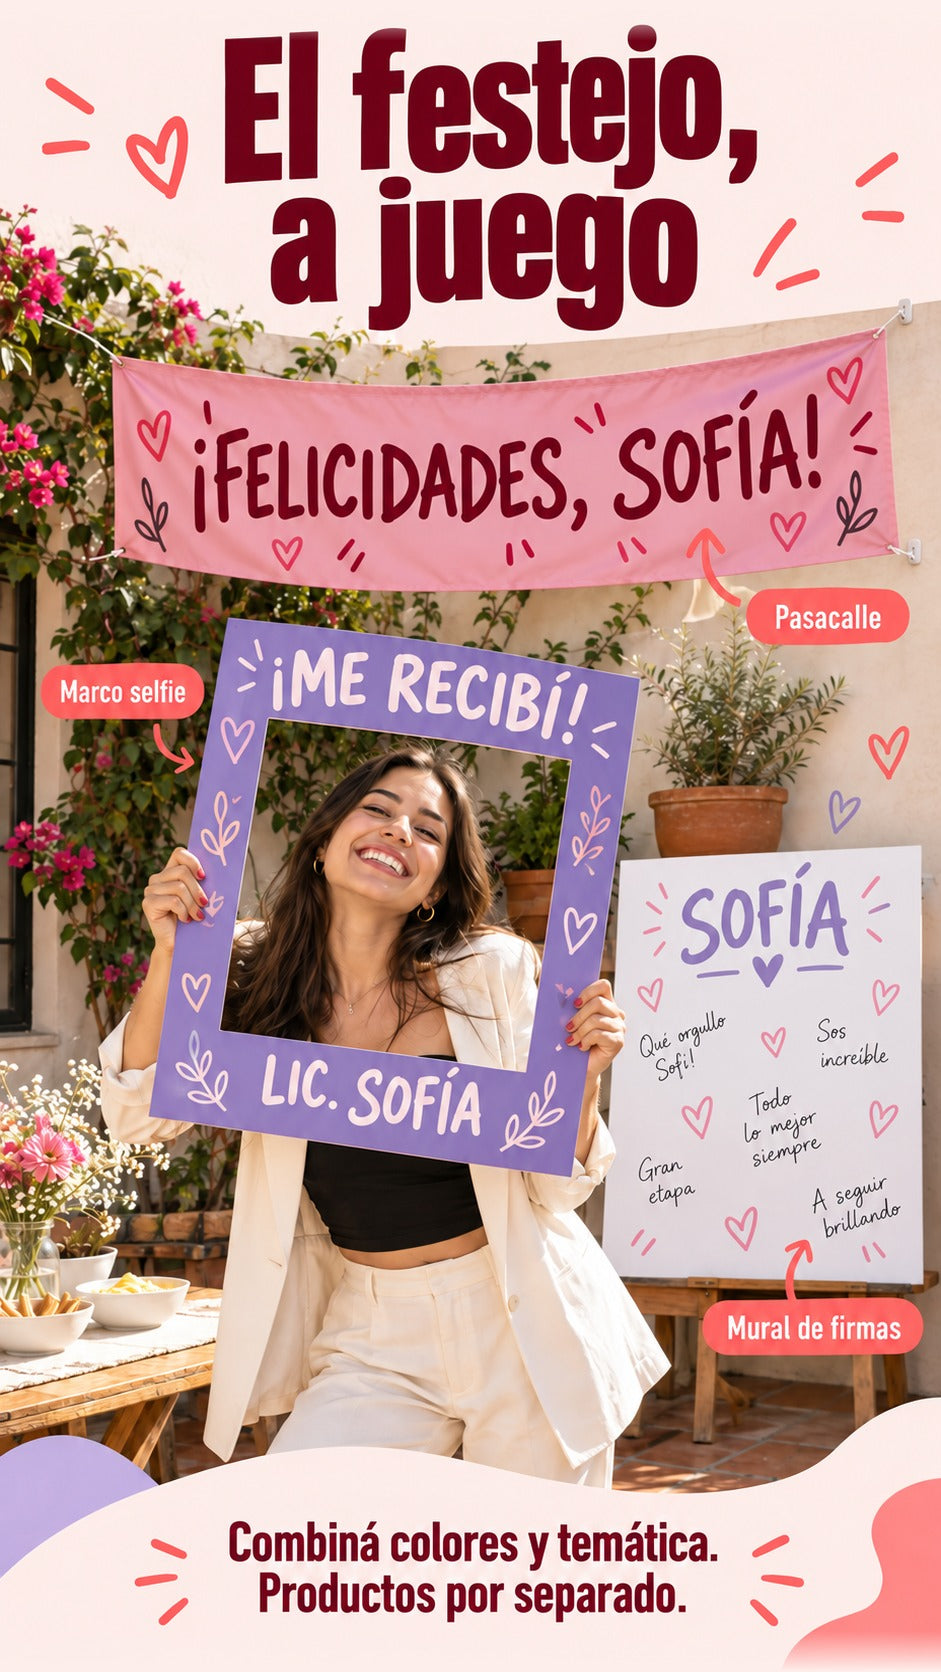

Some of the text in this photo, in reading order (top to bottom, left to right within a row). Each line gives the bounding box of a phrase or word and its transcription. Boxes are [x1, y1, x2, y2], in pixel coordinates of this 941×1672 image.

[195, 389, 822, 533] ¡FELICIDADES, SOFÍA!
[272, 647, 588, 744] ¡ME RECIBÍ!
[681, 861, 849, 964] SOFÍA
[639, 1010, 726, 1058] Qué orgullo
[816, 1018, 846, 1043] Sos
[655, 1048, 695, 1082] Sofi!
[821, 1042, 889, 1068] increíble
[261, 1054, 482, 1137] LIC. SOFÍA
[748, 1086, 792, 1116] Todo
[744, 1112, 817, 1143] lo mejor
[638, 1156, 683, 1182] Gran
[752, 1138, 822, 1168] siempre
[648, 1184, 696, 1208] etapa
[812, 1176, 887, 1214] A seguir
[822, 1197, 901, 1239] brillando
